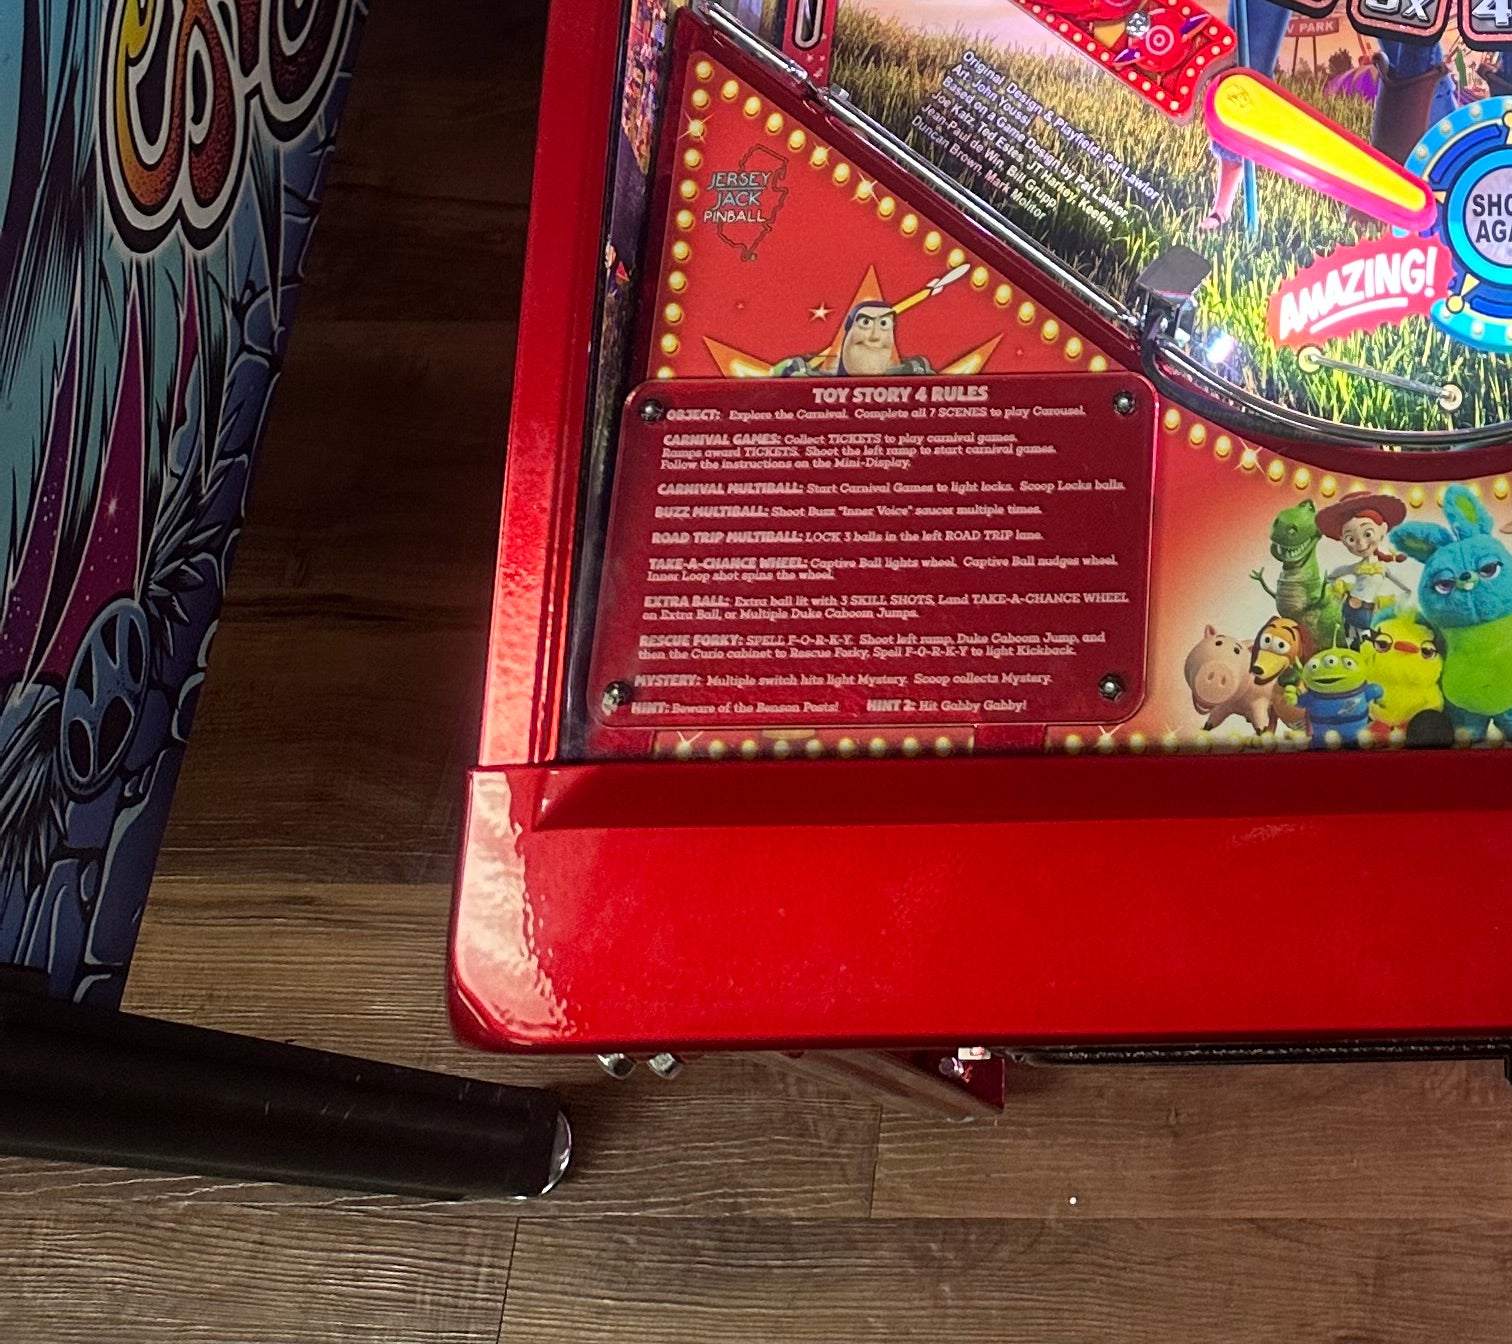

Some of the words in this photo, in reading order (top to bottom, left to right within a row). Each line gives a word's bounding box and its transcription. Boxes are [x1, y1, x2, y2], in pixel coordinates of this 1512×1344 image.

[1300, 20, 1336, 34] PARK
[972, 78, 998, 102] John
[999, 95, 1031, 127] Youssi
[942, 75, 974, 103] Based
[997, 113, 1026, 143] Game
[1027, 135, 1063, 170] Design
[963, 50, 1004, 87] Original
[1006, 81, 1043, 115] Design
[1102, 151, 1123, 171] Pat
[1122, 163, 1160, 201] Lawlor
[706, 169, 772, 190] JERSEY
[711, 190, 762, 208] JACK
[702, 208, 768, 225] PINBALL
[1276, 245, 1440, 333] AMAZING!
[812, 387, 849, 404] TOY
[852, 386, 912, 402] STORY
[914, 386, 927, 401] 4
[930, 385, 988, 401] RULES
[666, 408, 720, 420] OBJECT:
[728, 410, 772, 422] Explore
[774, 408, 794, 419] the
[854, 407, 908, 420] Complete
[910, 407, 926, 417] all
[929, 407, 935, 417] 7
[937, 406, 987, 417] SCENES
[989, 407, 1002, 416] to
[1003, 405, 1029, 418] play
[663, 433, 730, 445] CARNIVAL
[732, 433, 781, 445] GAMES:
[784, 434, 825, 444] Collect
[827, 433, 881, 446] TICKETS
[884, 433, 896, 443] to
[898, 432, 924, 445] play
[926, 431, 974, 442] carnival
[661, 447, 702, 459] Ramps
[704, 446, 740, 457] award
[804, 445, 839, 456] Shoot
[841, 445, 860, 455] the
[862, 444, 883, 455] left
[885, 444, 916, 458] ramp
[919, 443, 931, 454] to
[933, 445, 963, 455] start
[965, 443, 1013, 454] carnival
[630, 701, 669, 714] HINT:
[671, 702, 715, 713] Beware
[717, 701, 731, 713] of
[733, 701, 753, 713] the
[755, 701, 800, 712] Benson
[802, 701, 838, 712] Posts!
[866, 699, 901, 711] HINT
[902, 698, 916, 711] 2:
[918, 700, 938, 711] Hit
[940, 699, 980, 713] Gabby
[983, 699, 1026, 712] Gabby!
